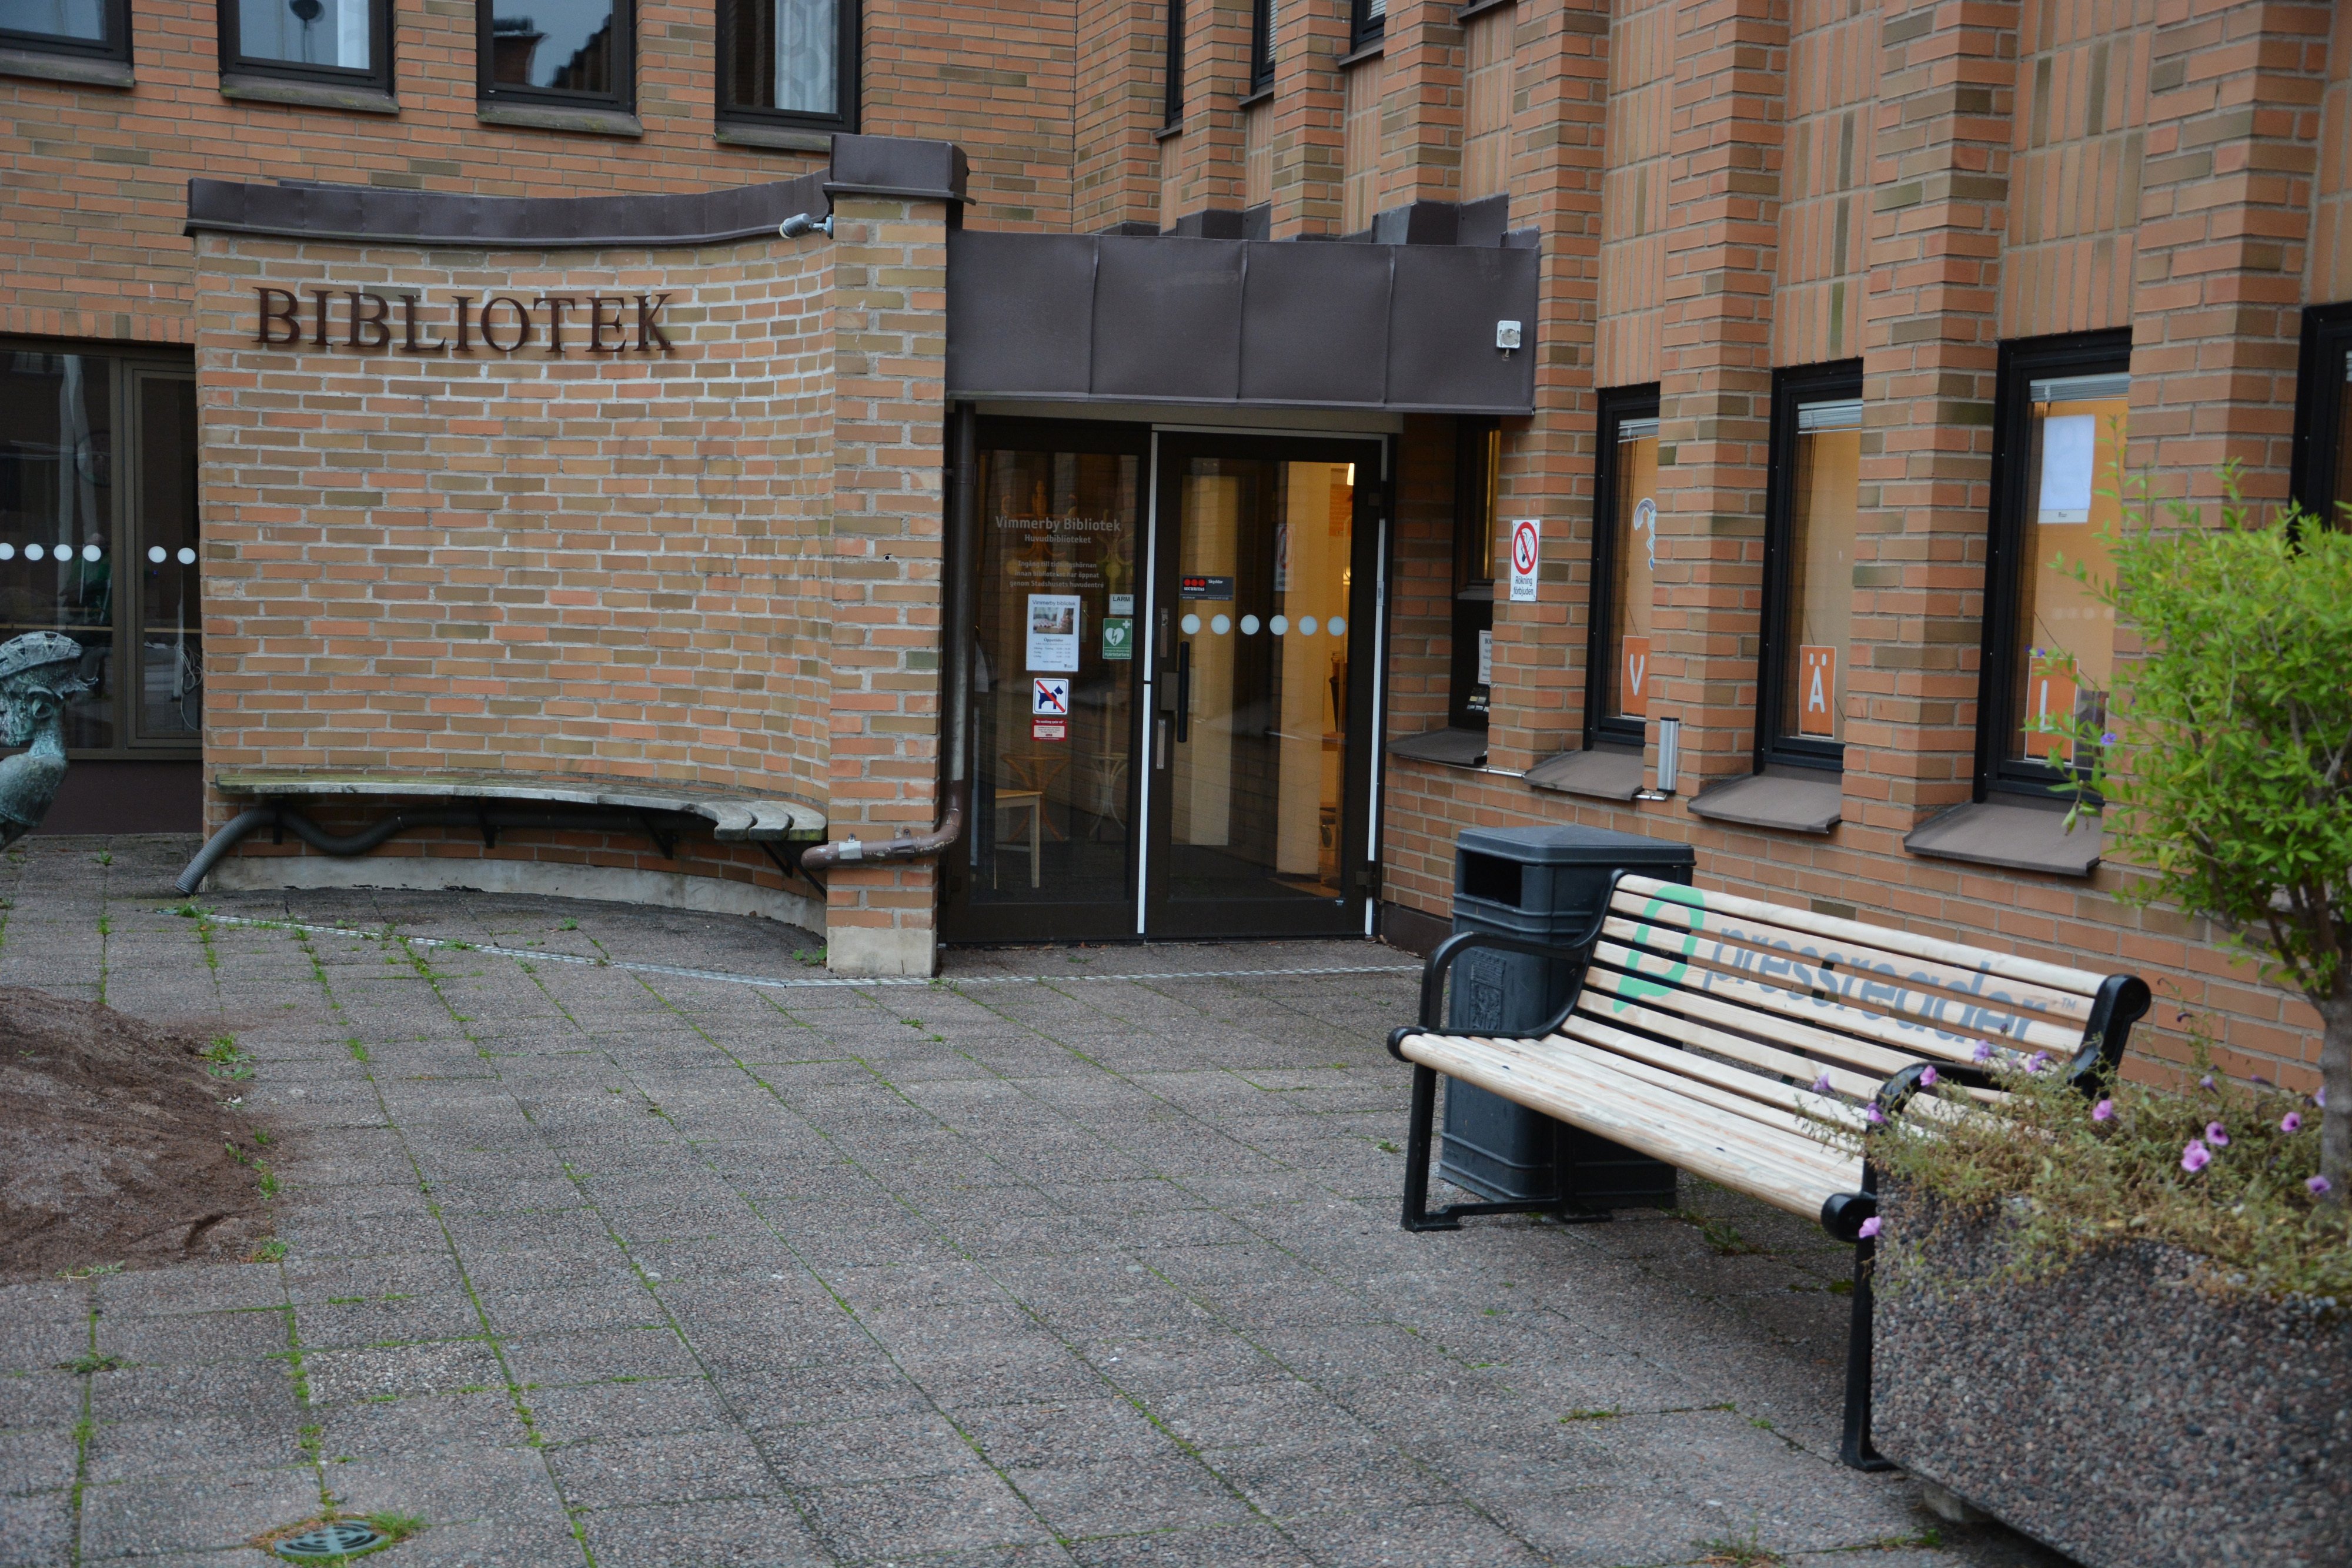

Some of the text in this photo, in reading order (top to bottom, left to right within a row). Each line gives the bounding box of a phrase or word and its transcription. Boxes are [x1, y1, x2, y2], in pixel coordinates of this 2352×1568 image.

[252, 286, 676, 353] BIBLIOTEK
[995, 516, 1121, 533] Vimmerby Bibliotek
[1025, 534, 1091, 543] Huvudbiblioteket
[1514, 586, 1534, 596] förbjuden
[1515, 576, 1532, 586] Rökning
[1629, 653, 1645, 696] V
[1809, 653, 1827, 713] Ä
[1703, 927, 2047, 1057] pressreader
